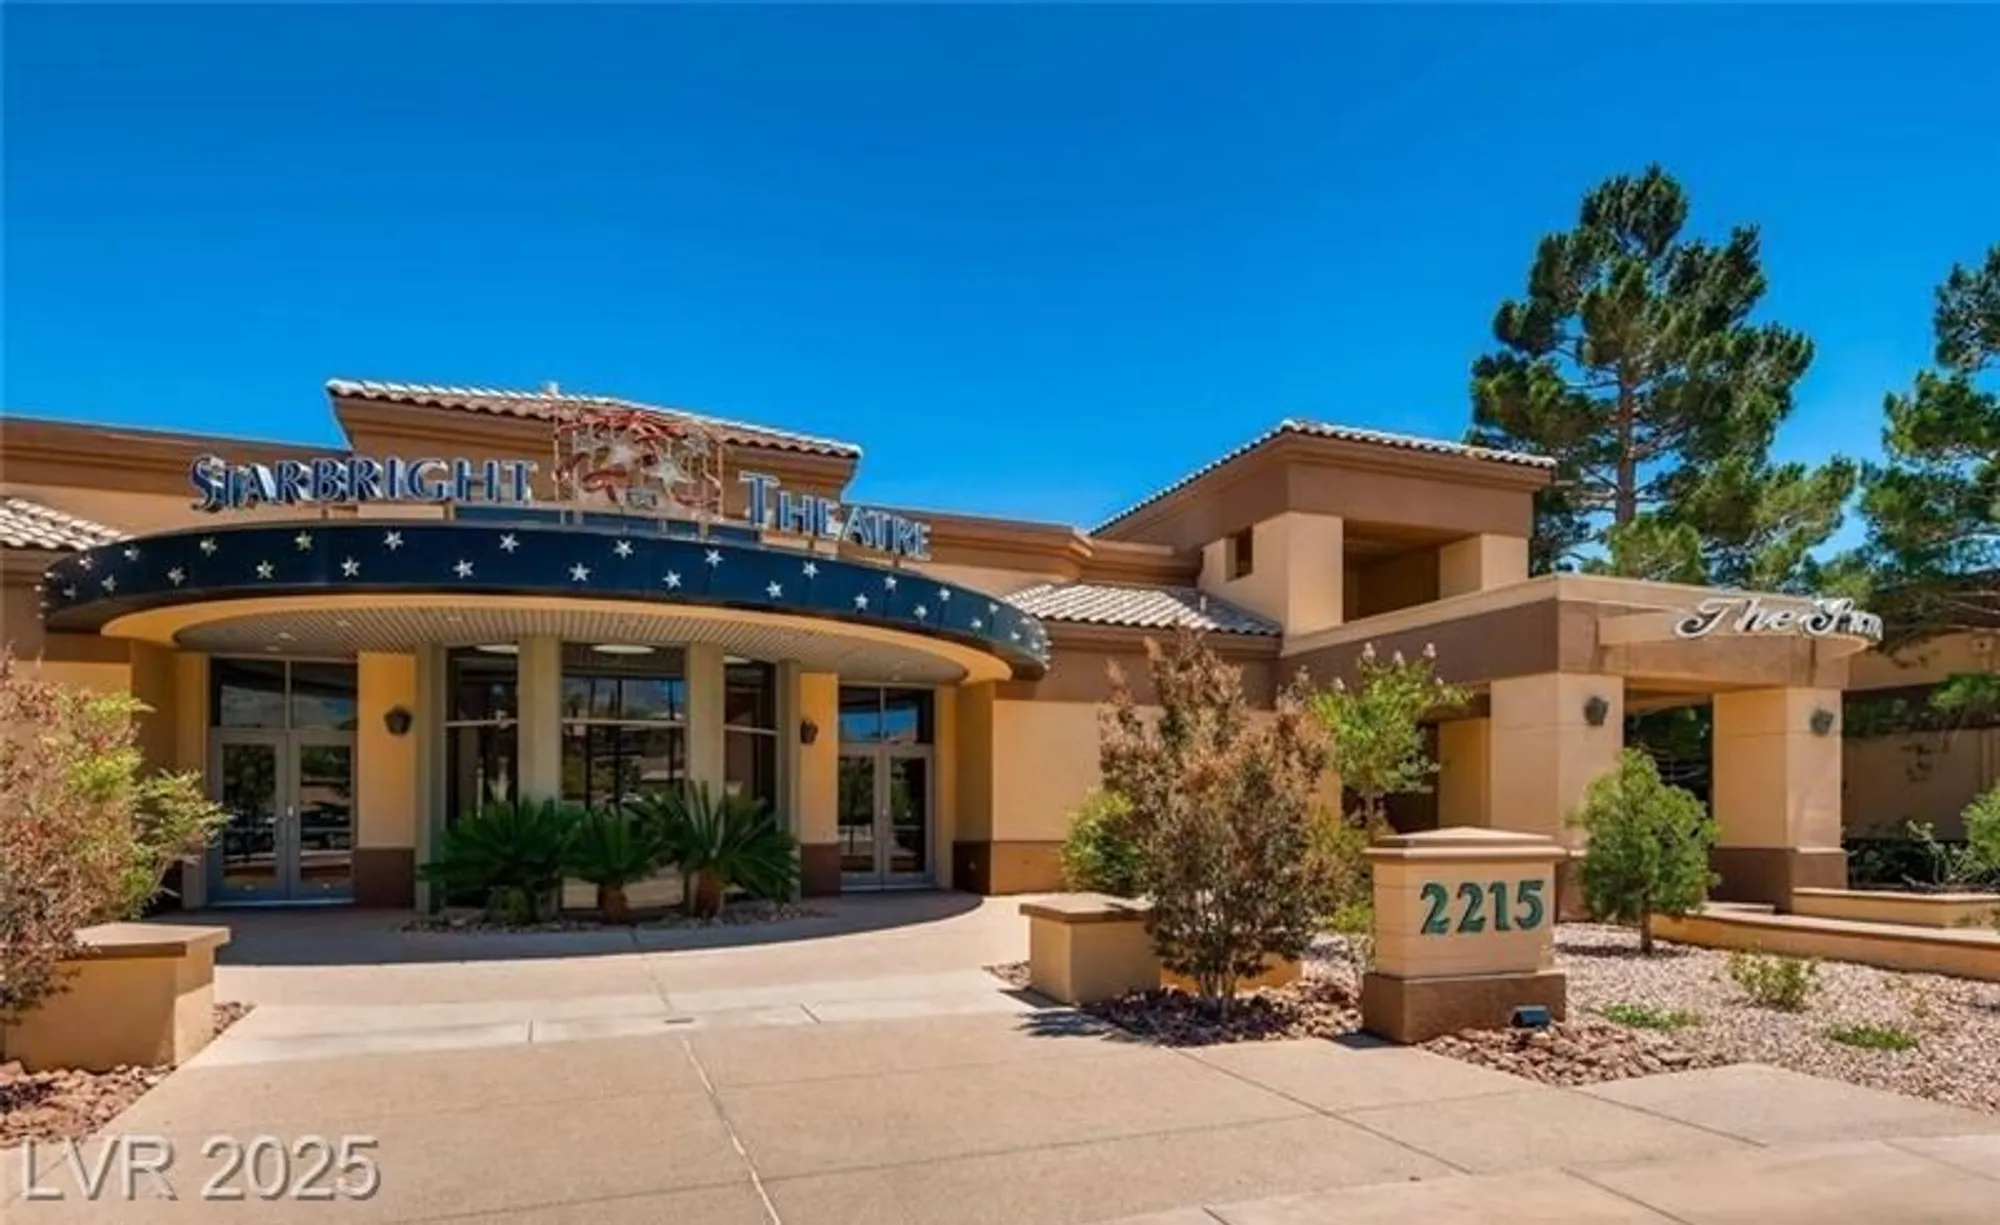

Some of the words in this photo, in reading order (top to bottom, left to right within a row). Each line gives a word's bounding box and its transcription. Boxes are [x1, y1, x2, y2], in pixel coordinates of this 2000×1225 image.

[191, 455, 539, 512] STARBRIGHT
[740, 471, 931, 560] THEATRE
[1675, 597, 1793, 639] The
[1420, 880, 1545, 935] 2215
